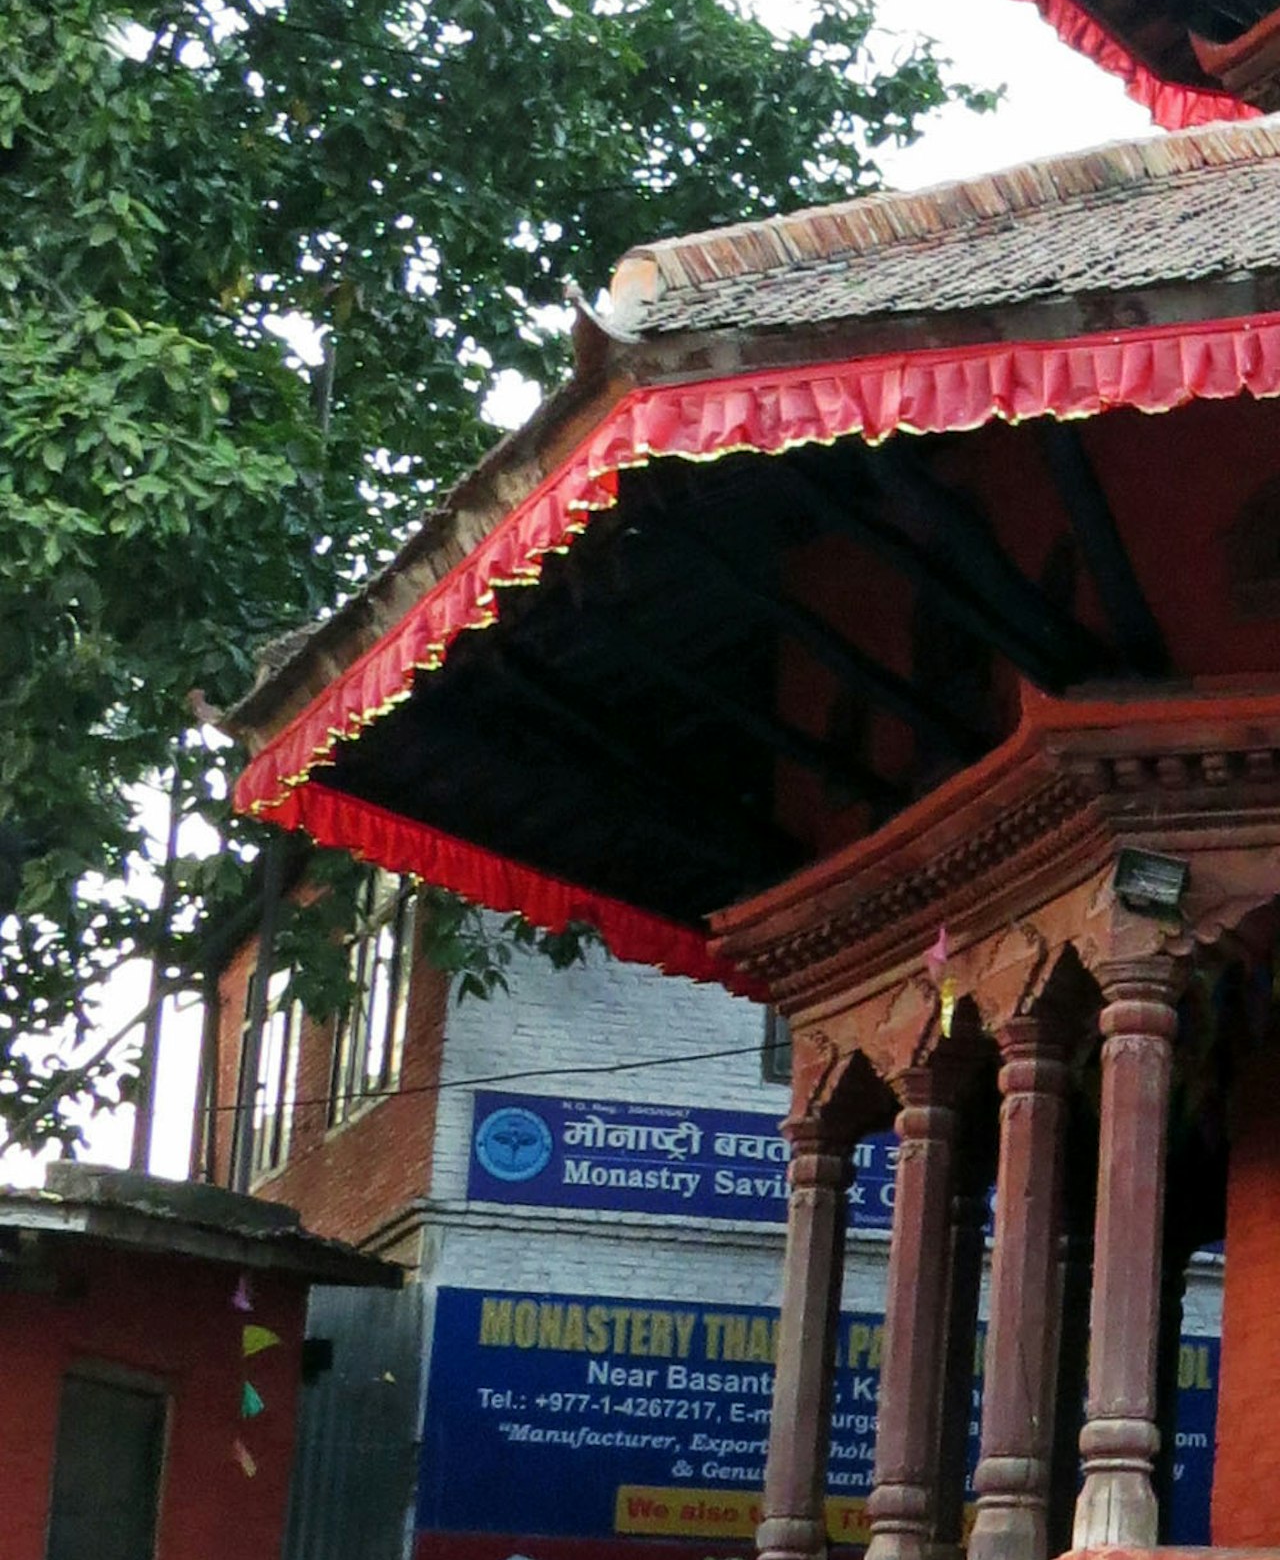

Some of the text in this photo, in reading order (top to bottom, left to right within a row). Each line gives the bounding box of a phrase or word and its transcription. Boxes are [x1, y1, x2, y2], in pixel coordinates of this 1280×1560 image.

[714, 1131, 790, 1163] बचत
[563, 1160, 701, 1198] Monastry
[479, 1297, 696, 1359] MONASTERY
[588, 1360, 658, 1389] Near
[478, 1388, 773, 1424] Tel.: +977-1-4267217, E-m
[690, 1432, 769, 1457] Export
[671, 1460, 694, 1479] &
[627, 1496, 668, 1520] We
[682, 1499, 739, 1523] also
